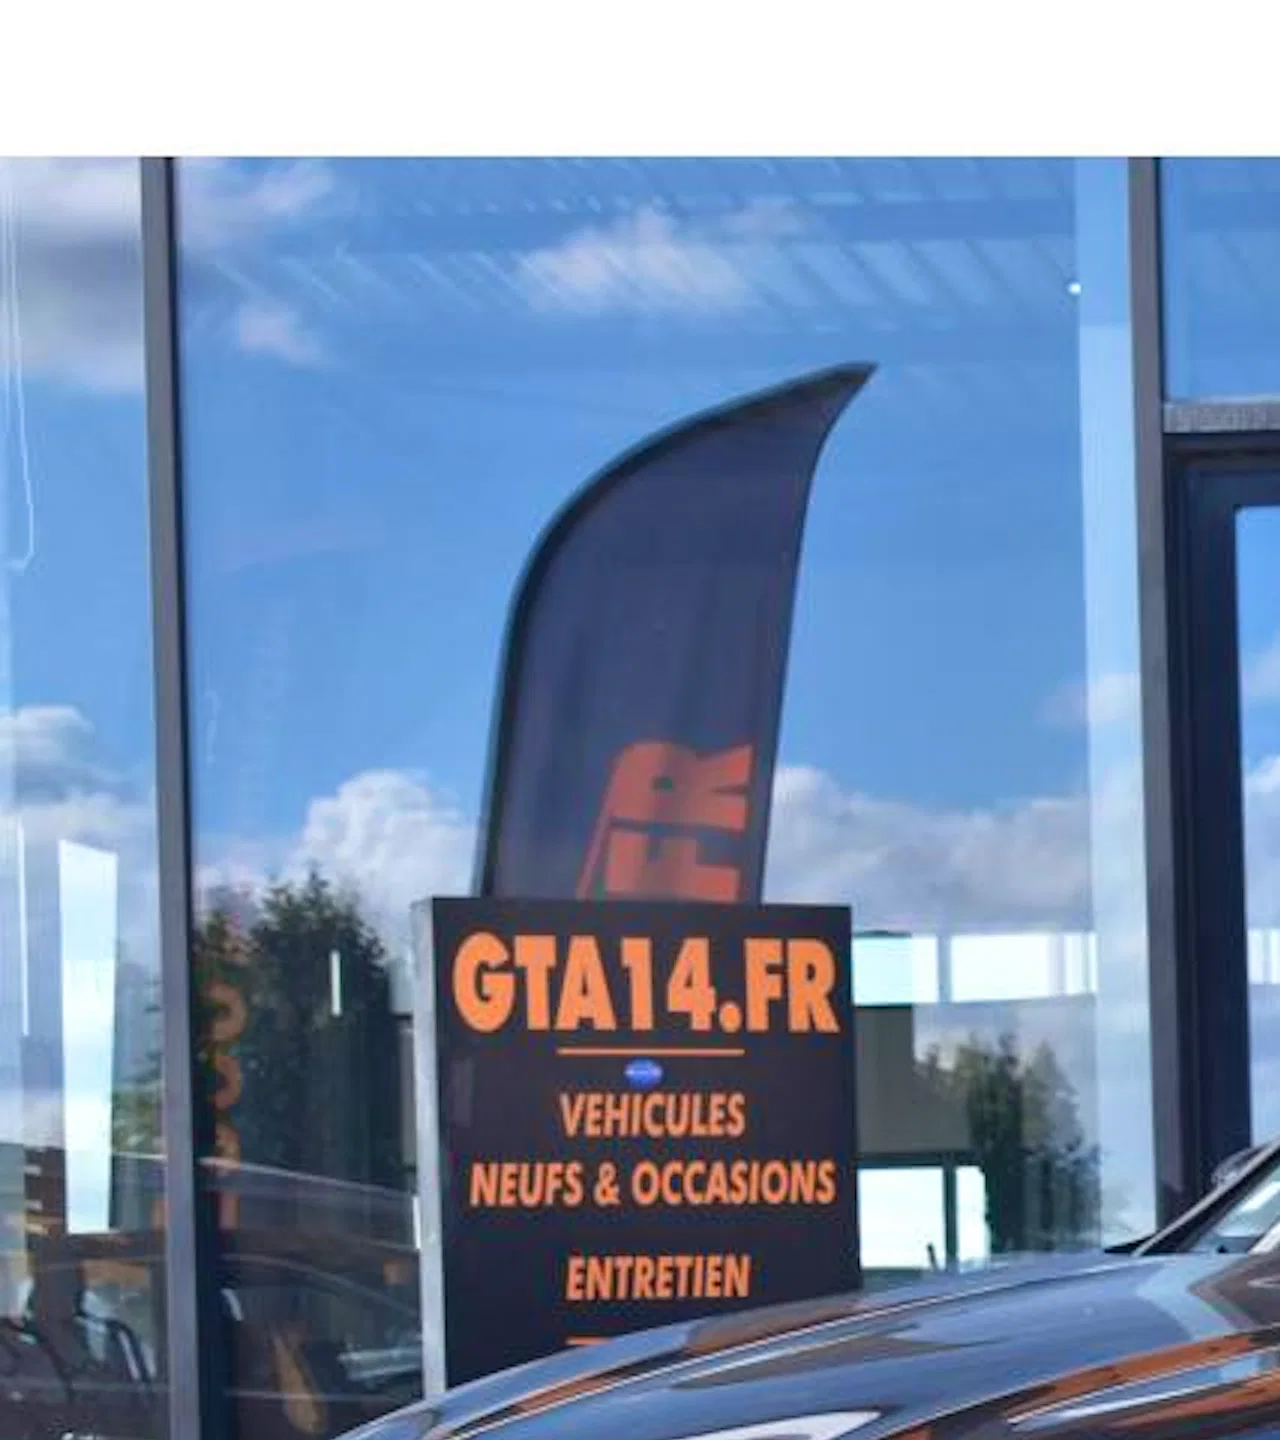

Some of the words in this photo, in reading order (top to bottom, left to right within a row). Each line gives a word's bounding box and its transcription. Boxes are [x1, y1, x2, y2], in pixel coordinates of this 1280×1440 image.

[452, 931, 840, 1034] GTA14.FR
[560, 1092, 746, 1138] VEHICULES
[470, 1161, 584, 1207] NEUFS
[593, 1162, 620, 1205] &
[630, 1160, 836, 1206] OCCASIONS
[566, 1254, 751, 1300] ENTRETIEN
